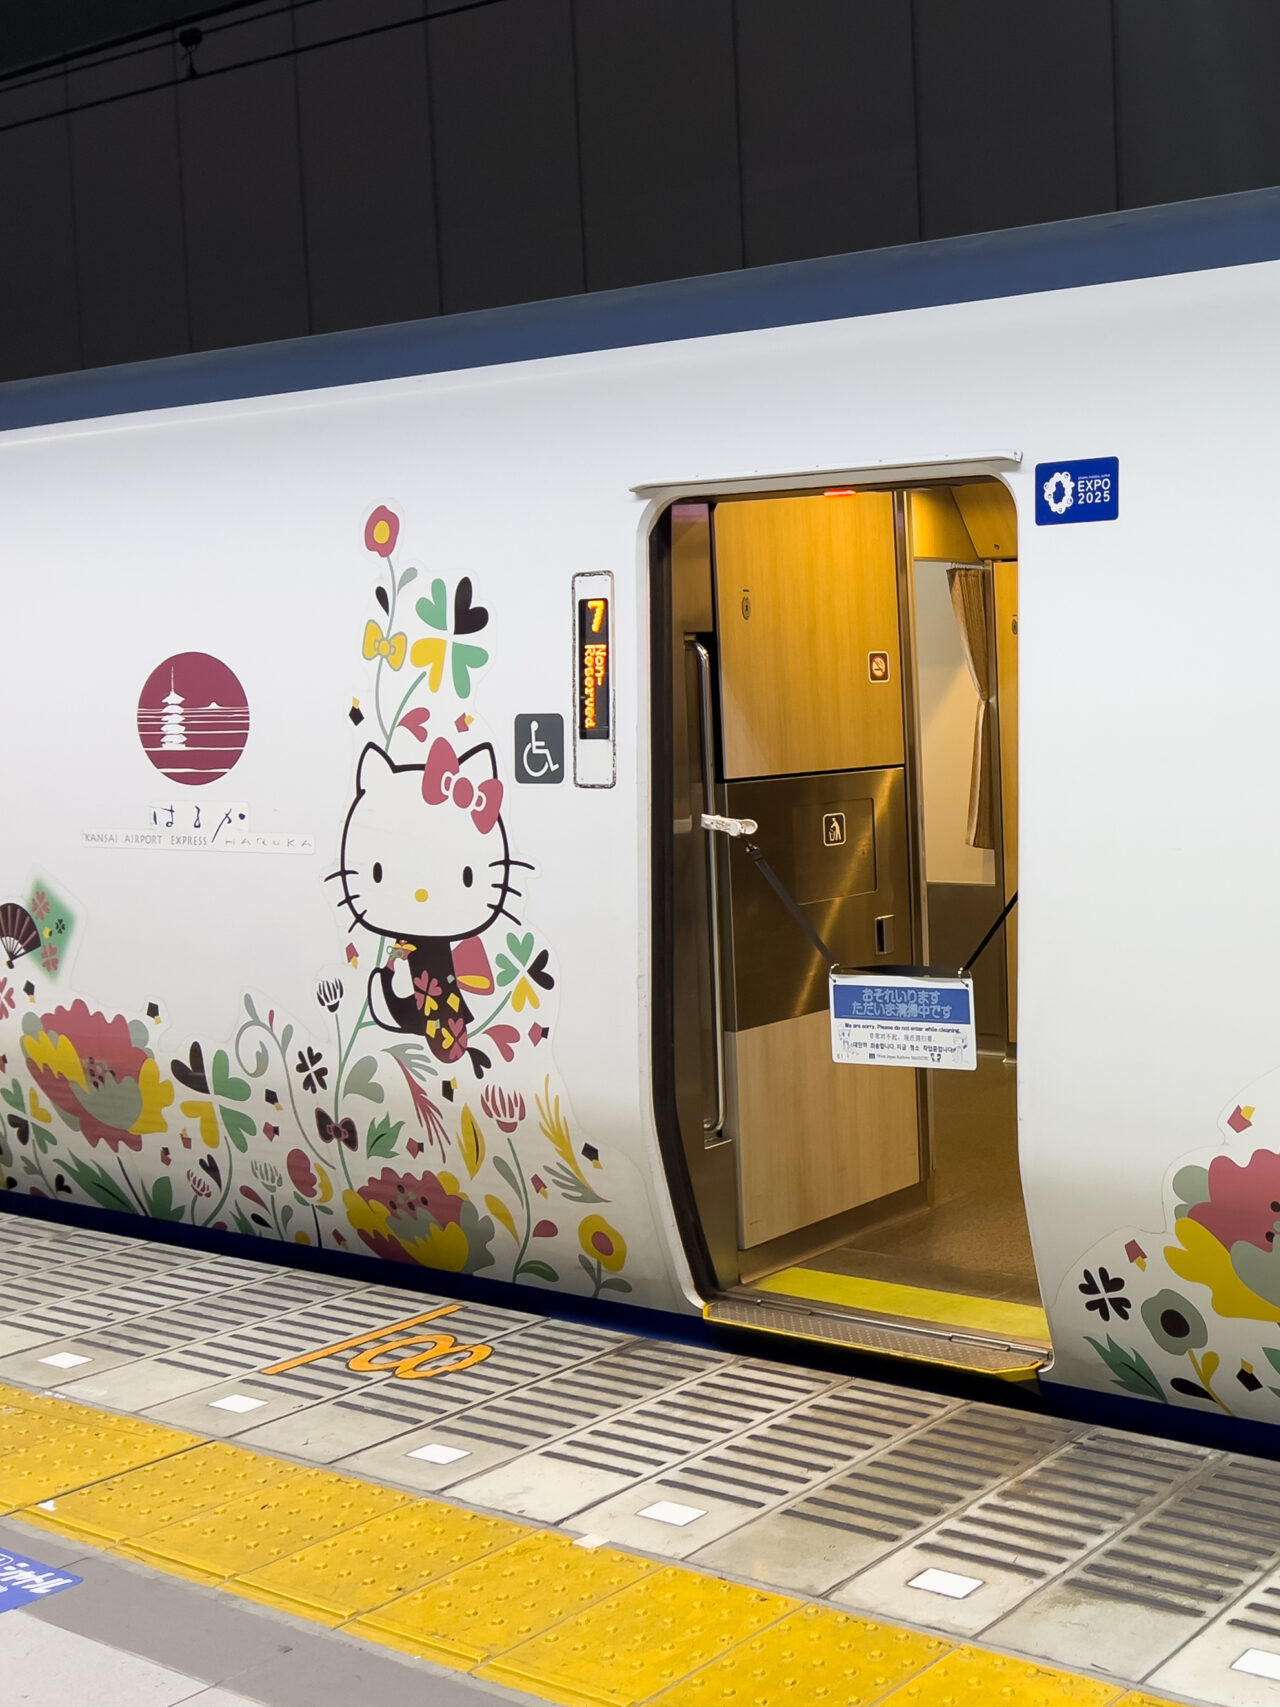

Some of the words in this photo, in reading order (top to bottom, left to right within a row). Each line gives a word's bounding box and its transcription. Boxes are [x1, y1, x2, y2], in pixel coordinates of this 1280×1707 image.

[1077, 478, 1111, 492] EXPO
[1077, 491, 1111, 505] 2025
[587, 600, 605, 633] 7
[595, 644, 607, 686] Non-
[584, 644, 596, 728] Reserved
[84, 833, 118, 844] KANSAI
[124, 834, 163, 845] AIRPORT
[170, 835, 208, 846] EXPRESS
[862, 988, 941, 1005] おそれいります
